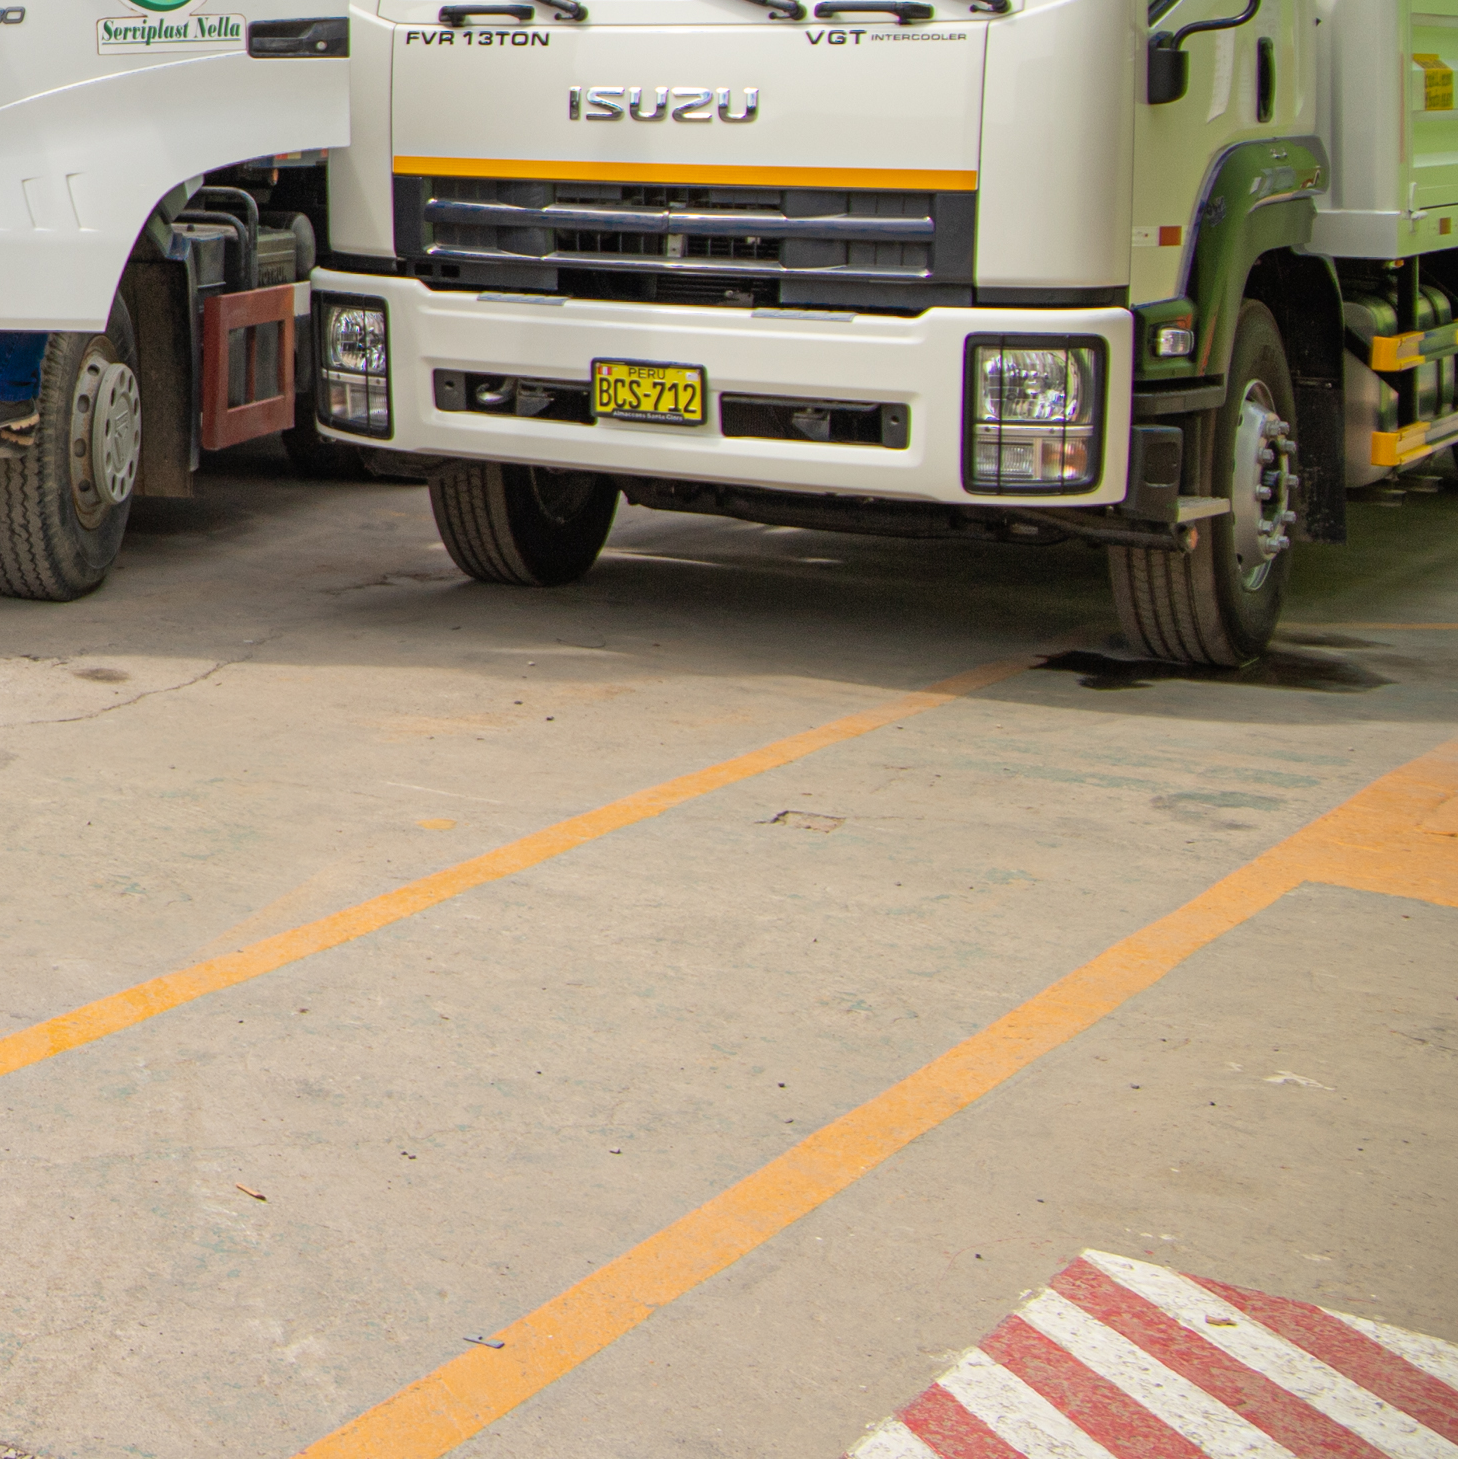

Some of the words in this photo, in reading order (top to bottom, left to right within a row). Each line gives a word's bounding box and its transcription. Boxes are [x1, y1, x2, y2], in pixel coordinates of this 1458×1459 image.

[102, 19, 190, 46] Serviplast
[194, 17, 241, 38] Nella
[406, 30, 455, 45] FVR
[463, 31, 550, 47] 13TON
[805, 29, 867, 45] VGT
[871, 33, 967, 41] INTERCOOLER
[568, 86, 759, 123] ISUZU
[628, 367, 666, 379] PERU
[599, 377, 697, 414] BCS-712
